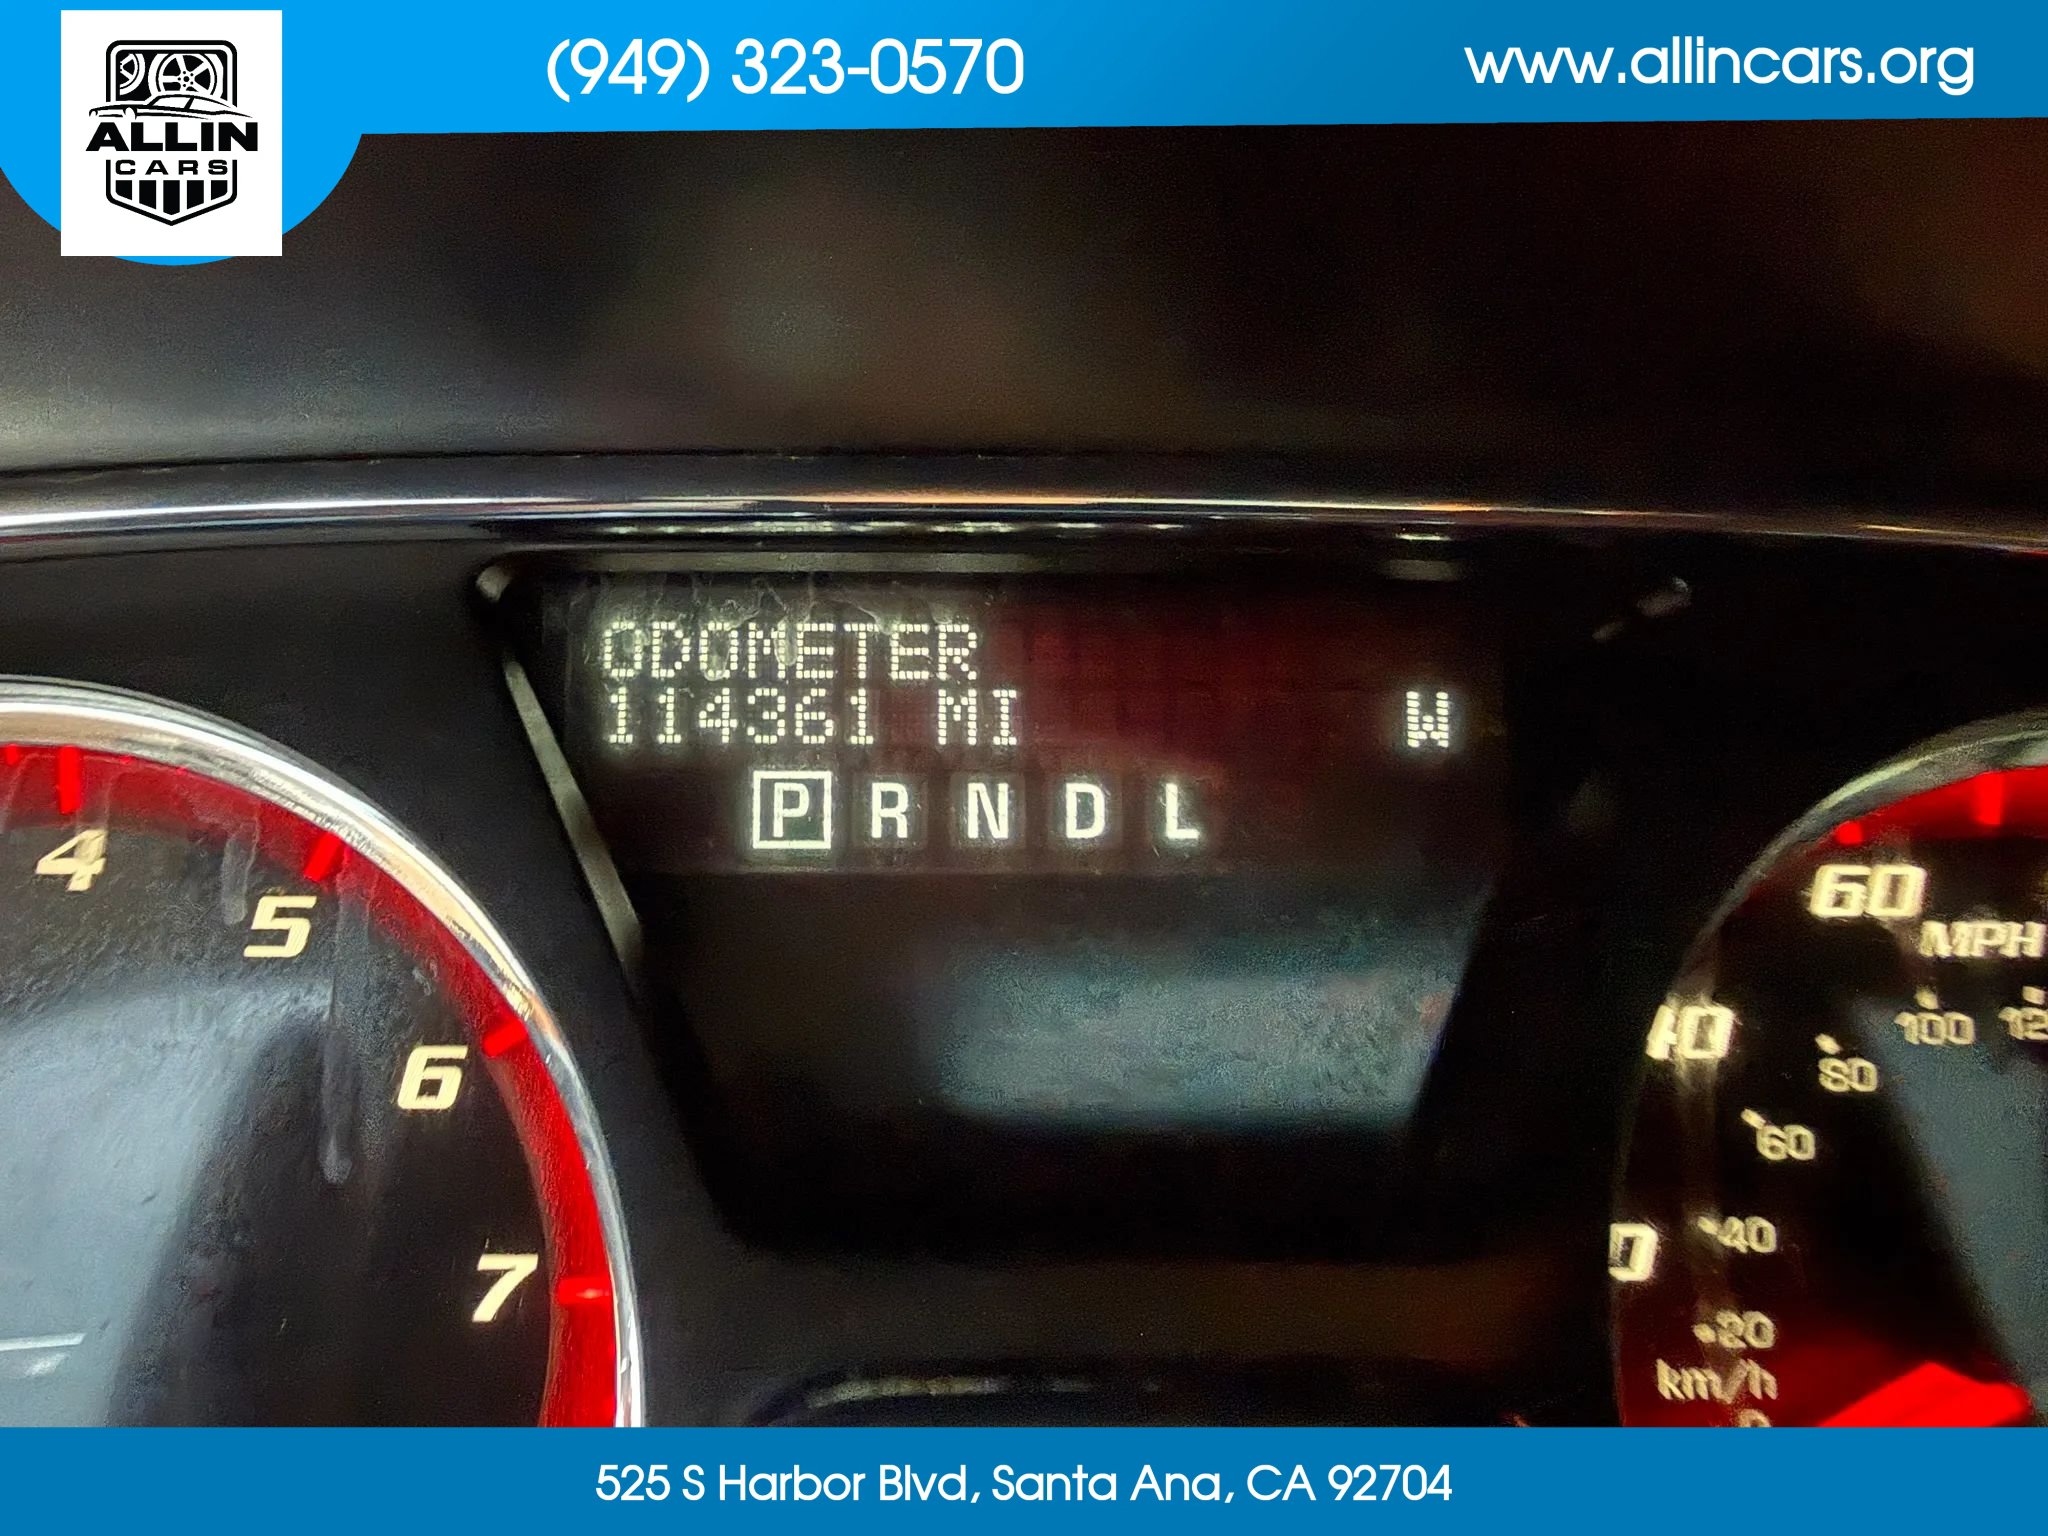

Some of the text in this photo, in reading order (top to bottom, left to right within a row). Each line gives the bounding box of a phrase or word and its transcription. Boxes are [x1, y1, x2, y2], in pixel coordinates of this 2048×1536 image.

[604, 621, 978, 680] ODOMETER
[610, 687, 1018, 746] 114361 MI
[1405, 690, 1451, 748] W
[772, 781, 1202, 839] P R N D L
[36, 829, 108, 892] 4
[1808, 863, 1928, 918] 60
[243, 896, 317, 959] 5
[1919, 920, 2046, 959] MPH
[1893, 1012, 1977, 1046] 100
[396, 1044, 469, 1111] 6
[1756, 1124, 1816, 1160] 60
[1716, 1216, 1778, 1254] 40
[472, 1253, 539, 1323] 7
[1716, 1310, 1777, 1350] 20
[1656, 1358, 1779, 1404] km/h
